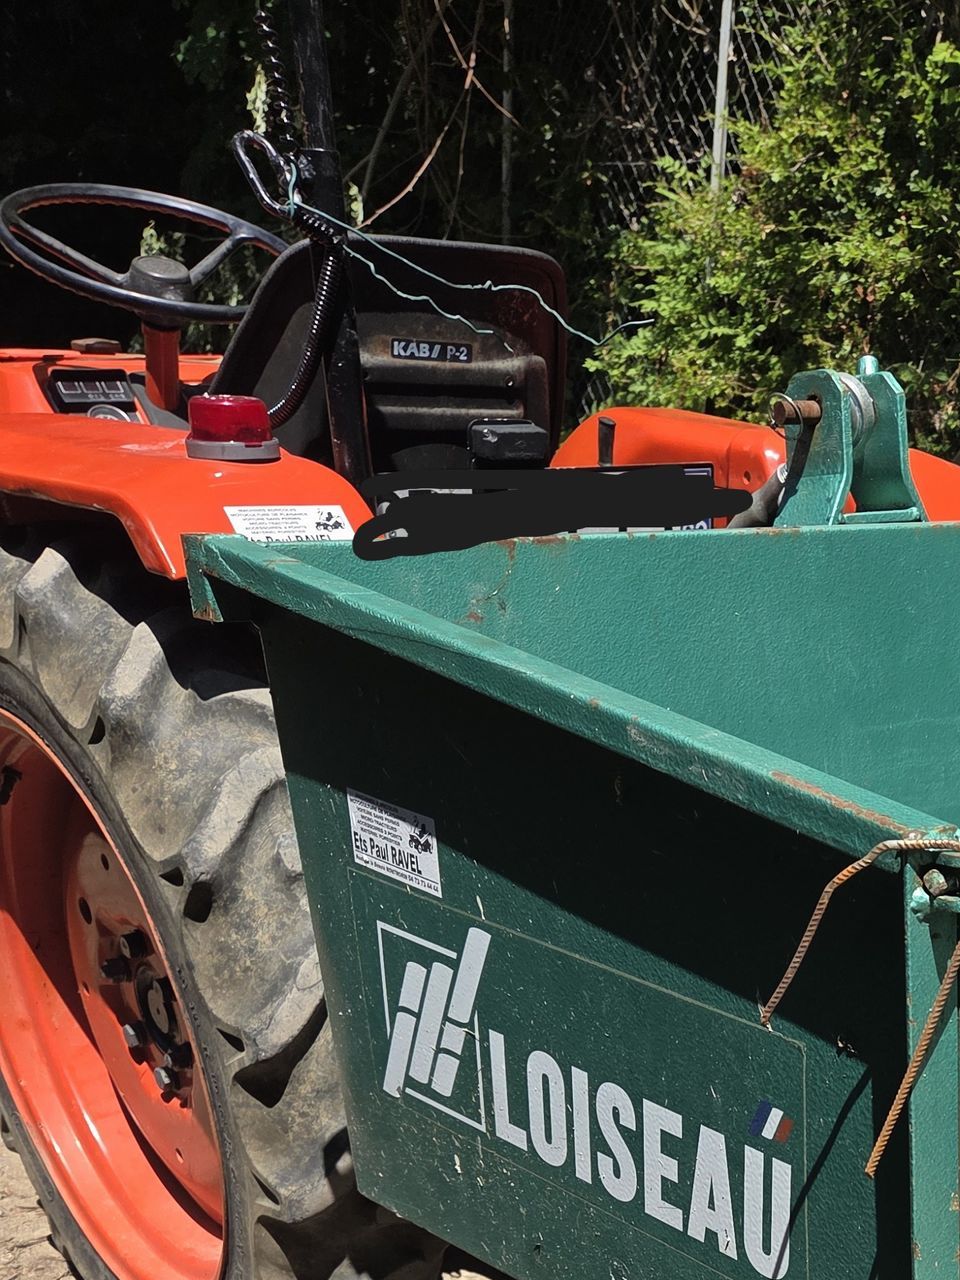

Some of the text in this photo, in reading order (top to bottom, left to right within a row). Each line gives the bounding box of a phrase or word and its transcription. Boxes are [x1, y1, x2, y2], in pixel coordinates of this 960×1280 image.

[447, 346, 468, 360] P-2
[353, 830, 368, 853] Ets
[369, 836, 389, 861] Paul
[390, 845, 422, 875] RAVEL
[489, 1028, 792, 1280] LOISEAU
